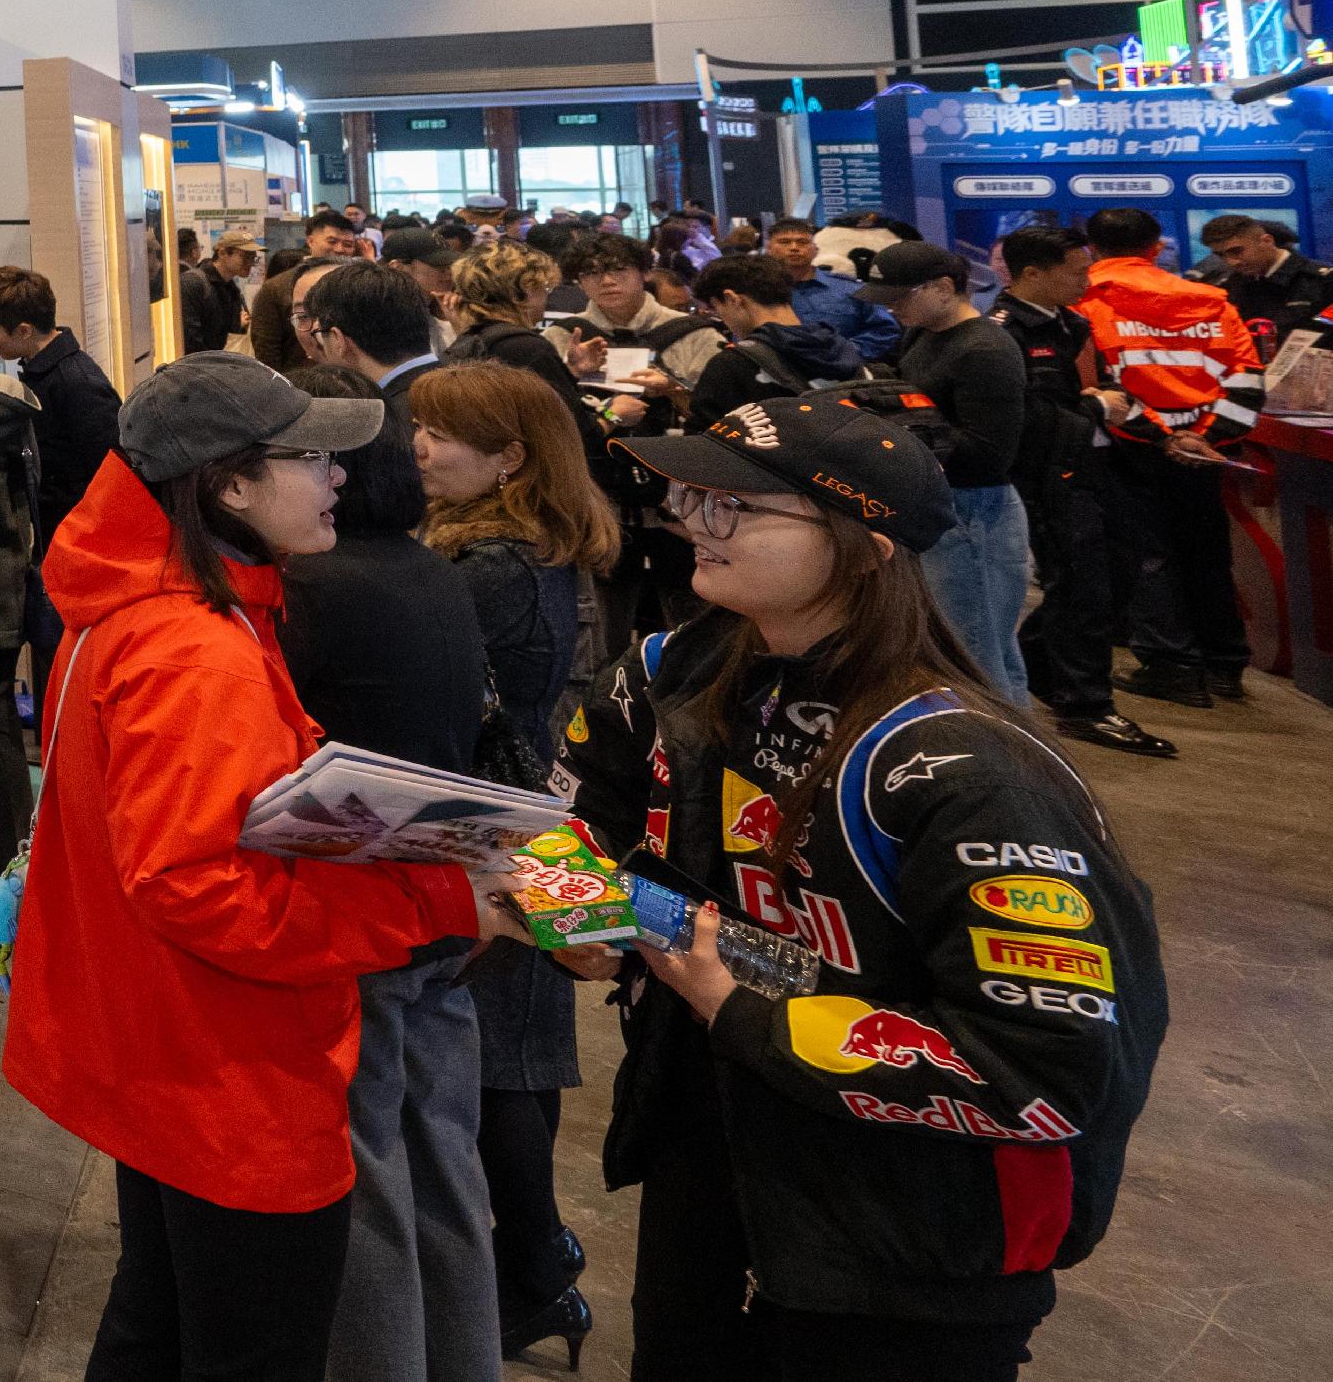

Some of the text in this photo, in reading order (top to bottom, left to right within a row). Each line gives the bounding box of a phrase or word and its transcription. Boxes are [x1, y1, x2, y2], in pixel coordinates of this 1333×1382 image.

[811, 471, 898, 519] LEGACY
[955, 841, 1090, 877] CASIO
[1007, 888, 1087, 920] RAUCH
[979, 979, 1120, 1027] GEOX
[837, 1090, 1083, 1142] Red Bull
